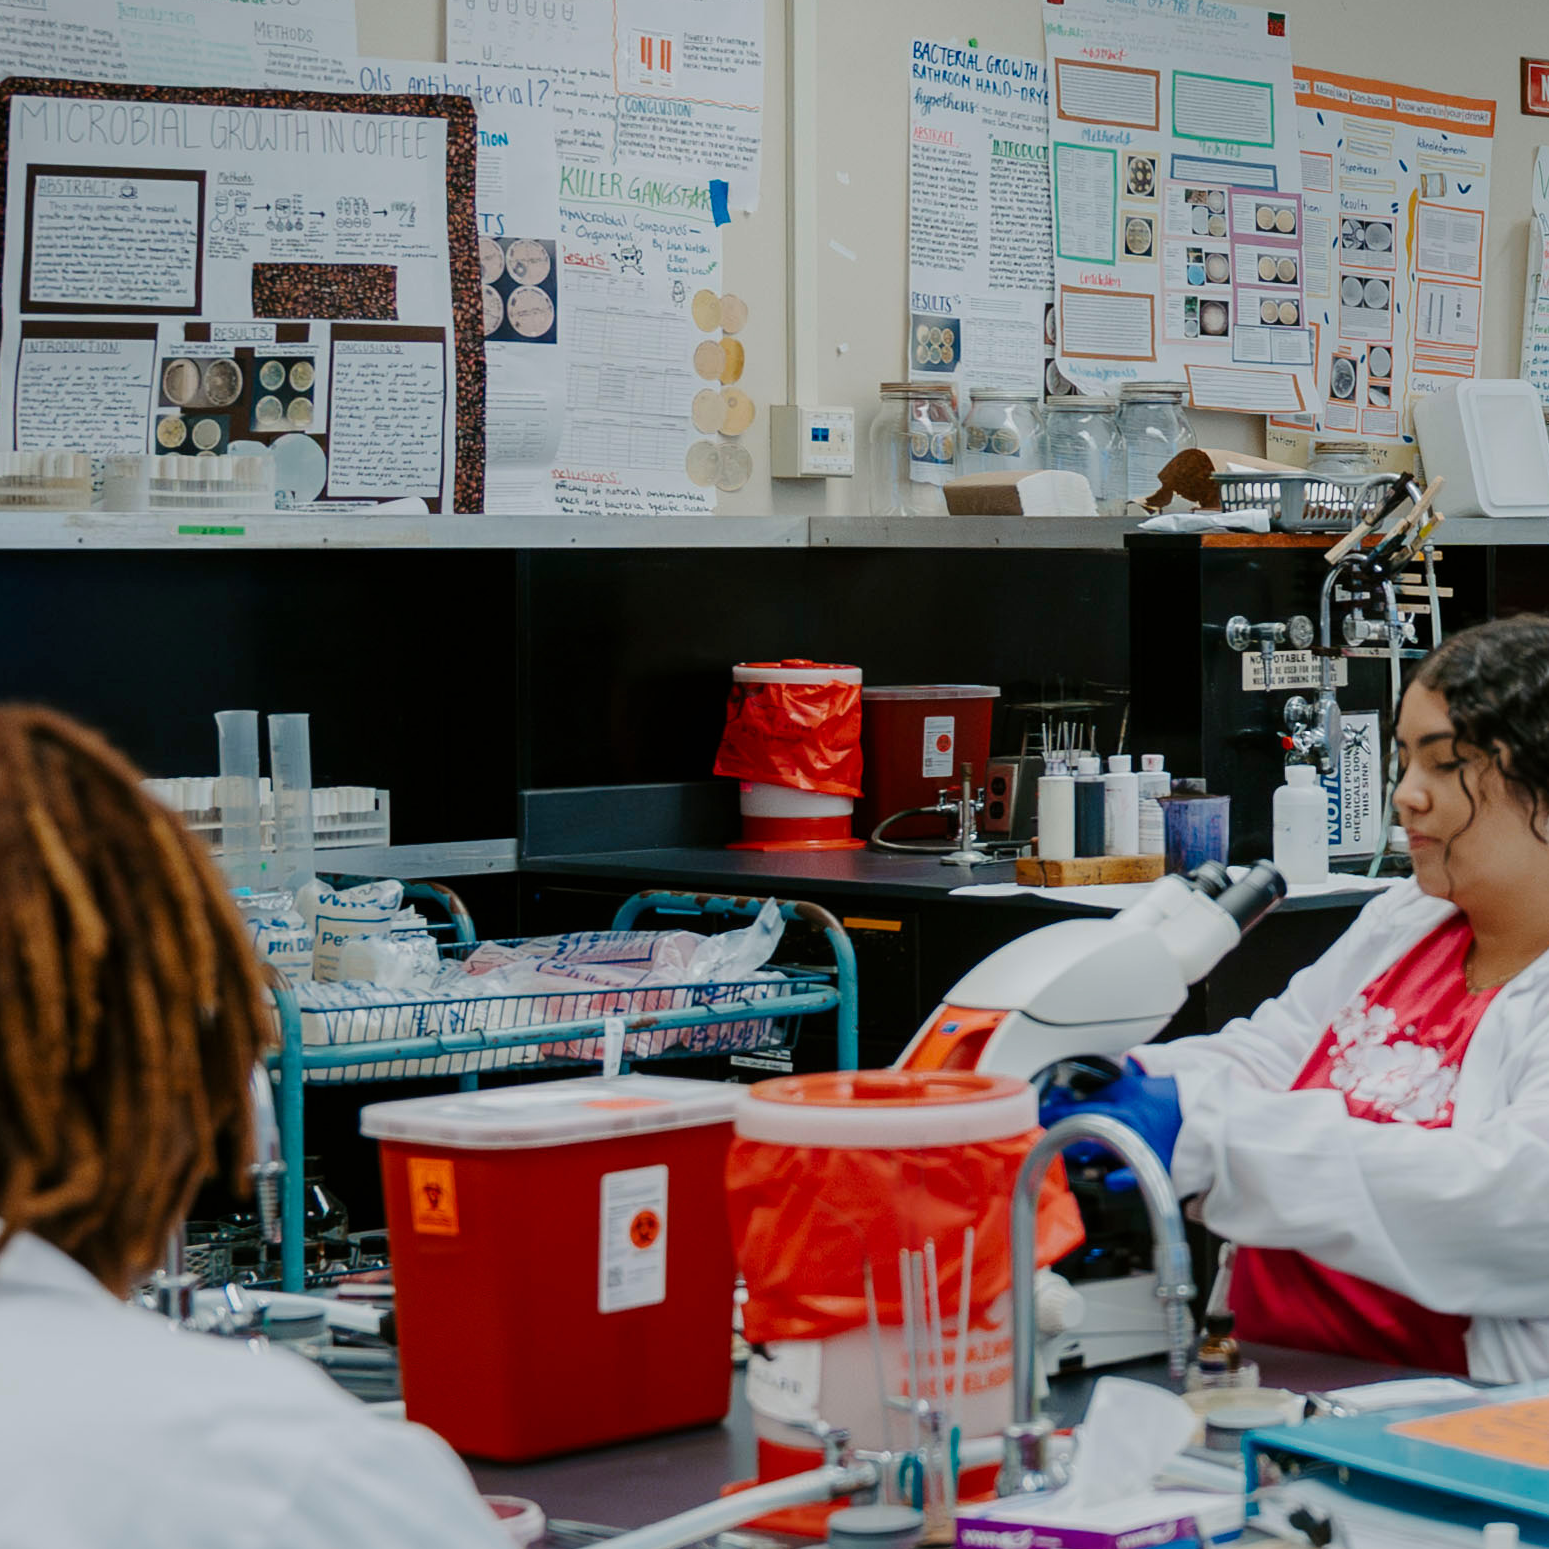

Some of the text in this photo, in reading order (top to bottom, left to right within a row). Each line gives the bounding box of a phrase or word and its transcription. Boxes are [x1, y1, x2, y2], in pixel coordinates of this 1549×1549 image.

[254, 20, 315, 44] METHODS
[913, 41, 1038, 81] BACTERIAL GROWTH
[913, 63, 970, 88] BATHROOM
[19, 101, 429, 160] MICROBIAL GROWTH IN COFFEE
[559, 165, 623, 200] KILLER
[1362, 761, 1370, 817] THIS SINK
[1345, 817, 1352, 829] DO
[1353, 775, 1361, 842] CHEMICALS
